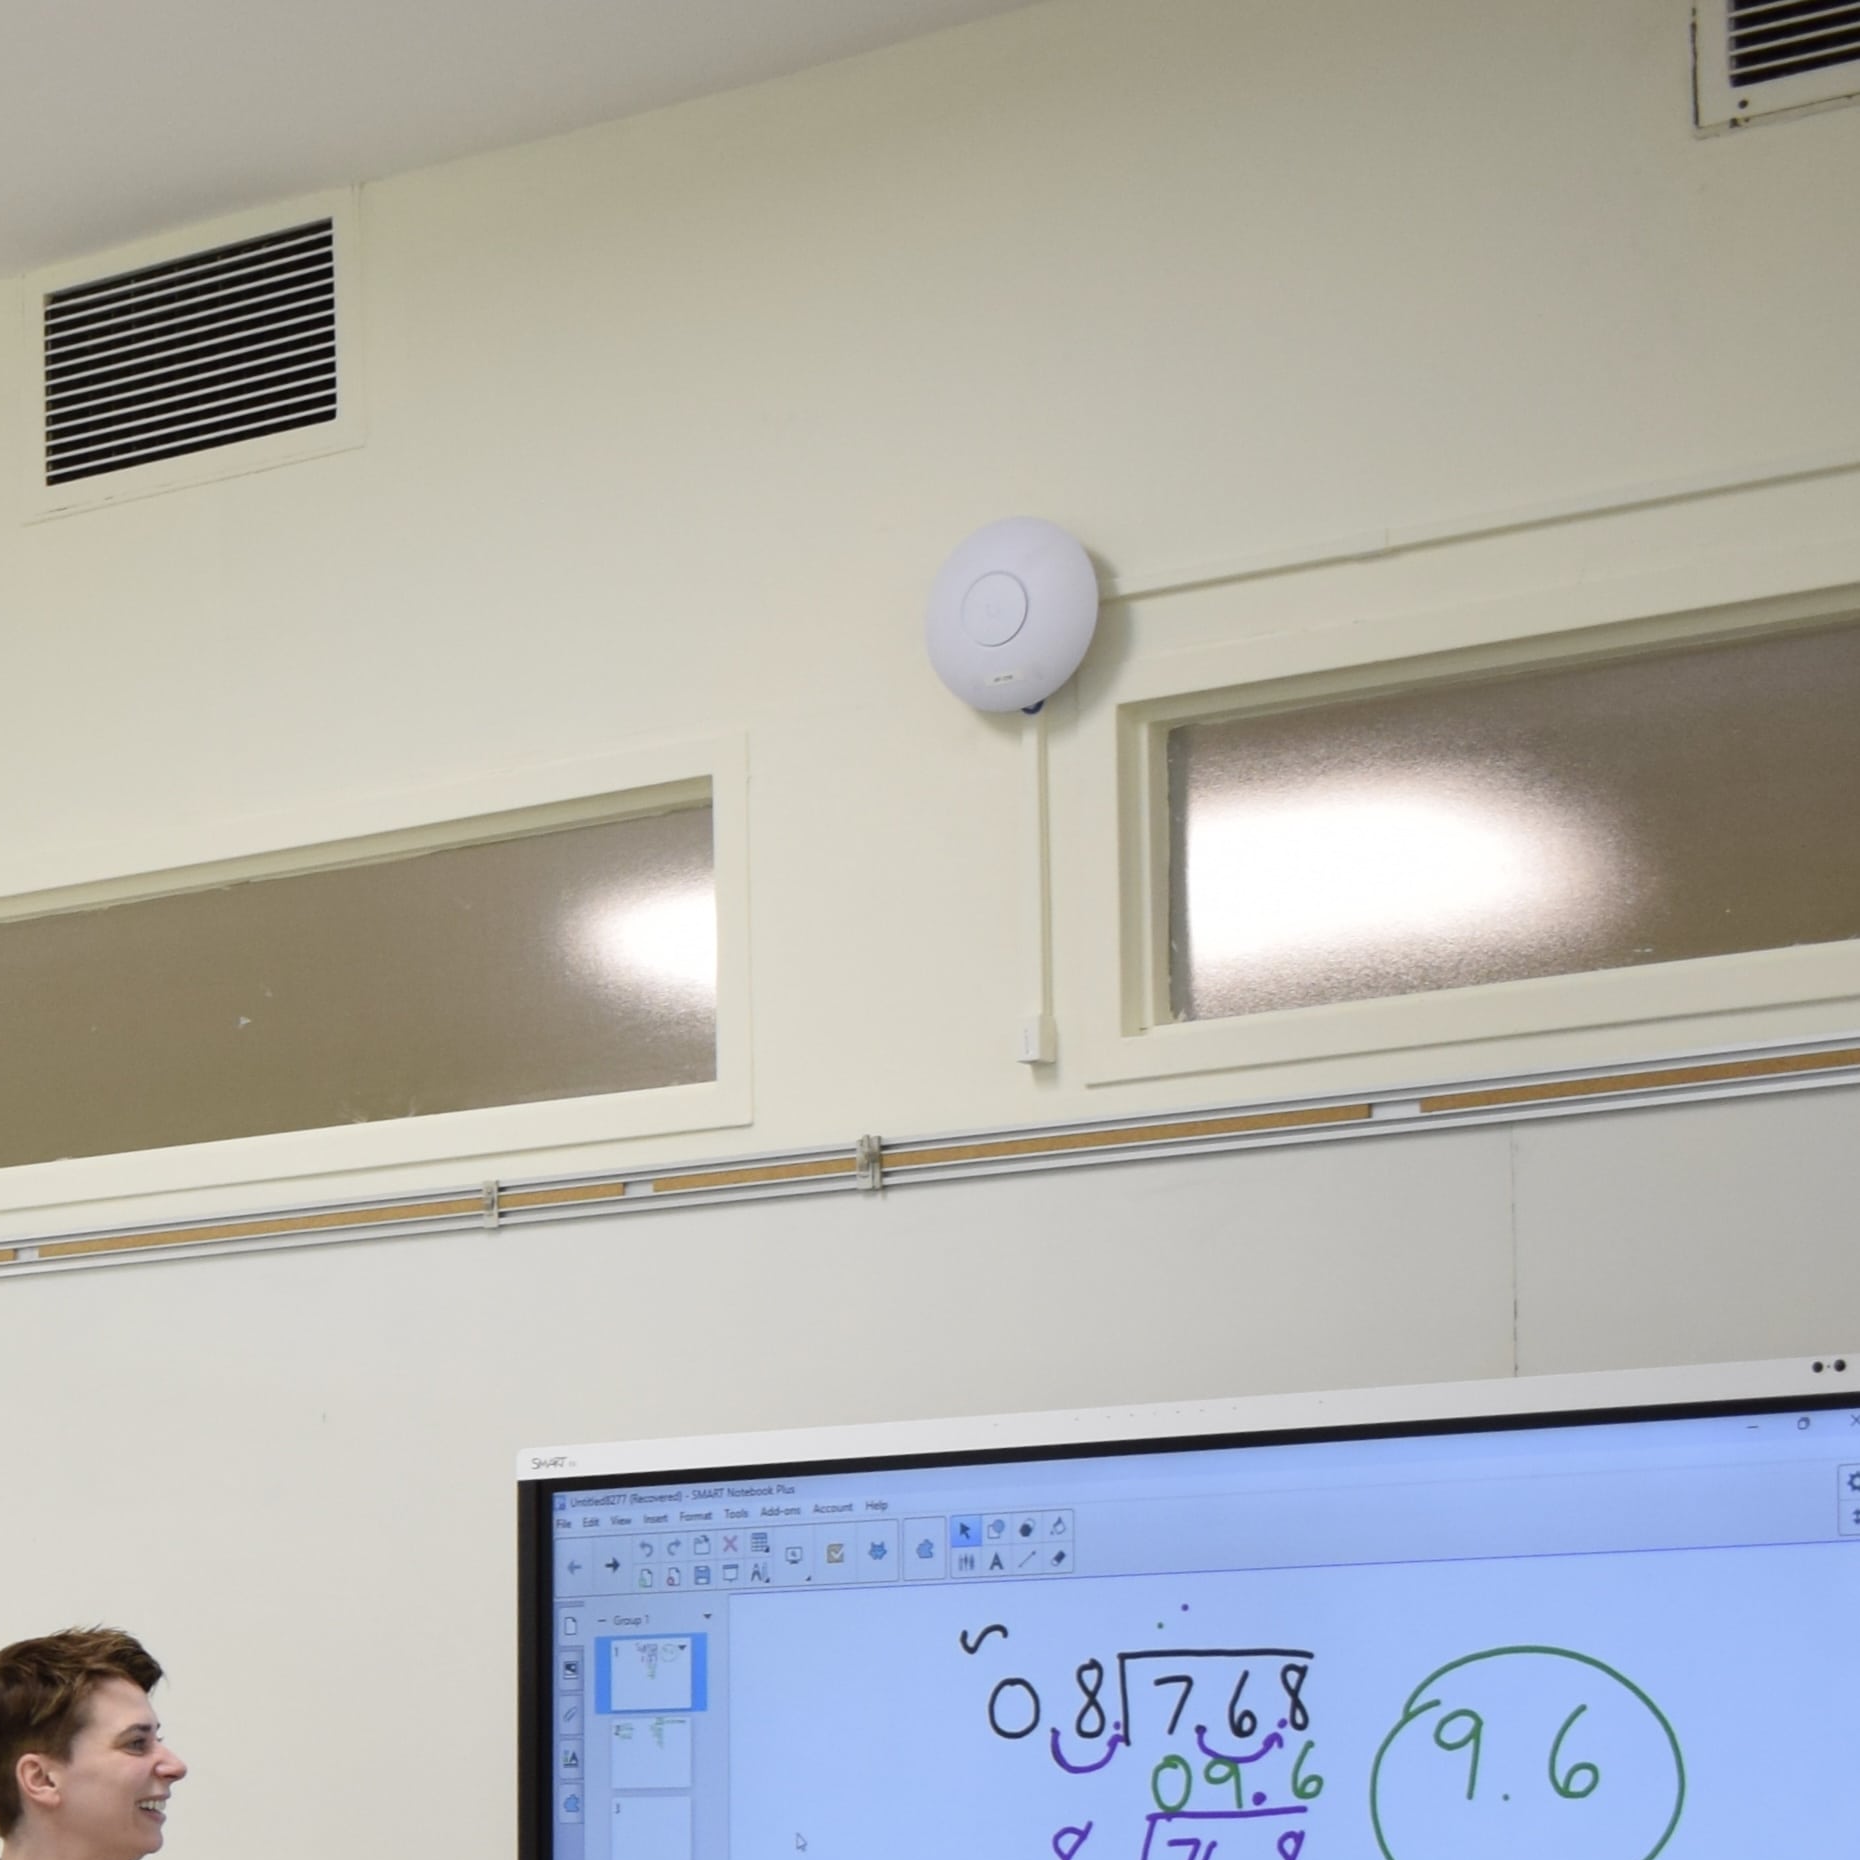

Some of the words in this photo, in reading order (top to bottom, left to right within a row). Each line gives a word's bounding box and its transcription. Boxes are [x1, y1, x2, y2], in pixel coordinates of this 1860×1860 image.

[692, 1488, 724, 1500] SMART
[727, 1486, 773, 1498] Notebook
[776, 1484, 795, 1495] Plus
[556, 1518, 571, 1529] File
[583, 1516, 600, 1527] Edit
[611, 1515, 632, 1526] View
[643, 1513, 668, 1523] Insert
[680, 1511, 712, 1521] Format
[725, 1508, 748, 1519] Tools
[760, 1506, 801, 1517] Add-ons
[813, 1503, 853, 1513] Account
[865, 1500, 888, 1512] Help
[614, 1615, 641, 1628] Group
